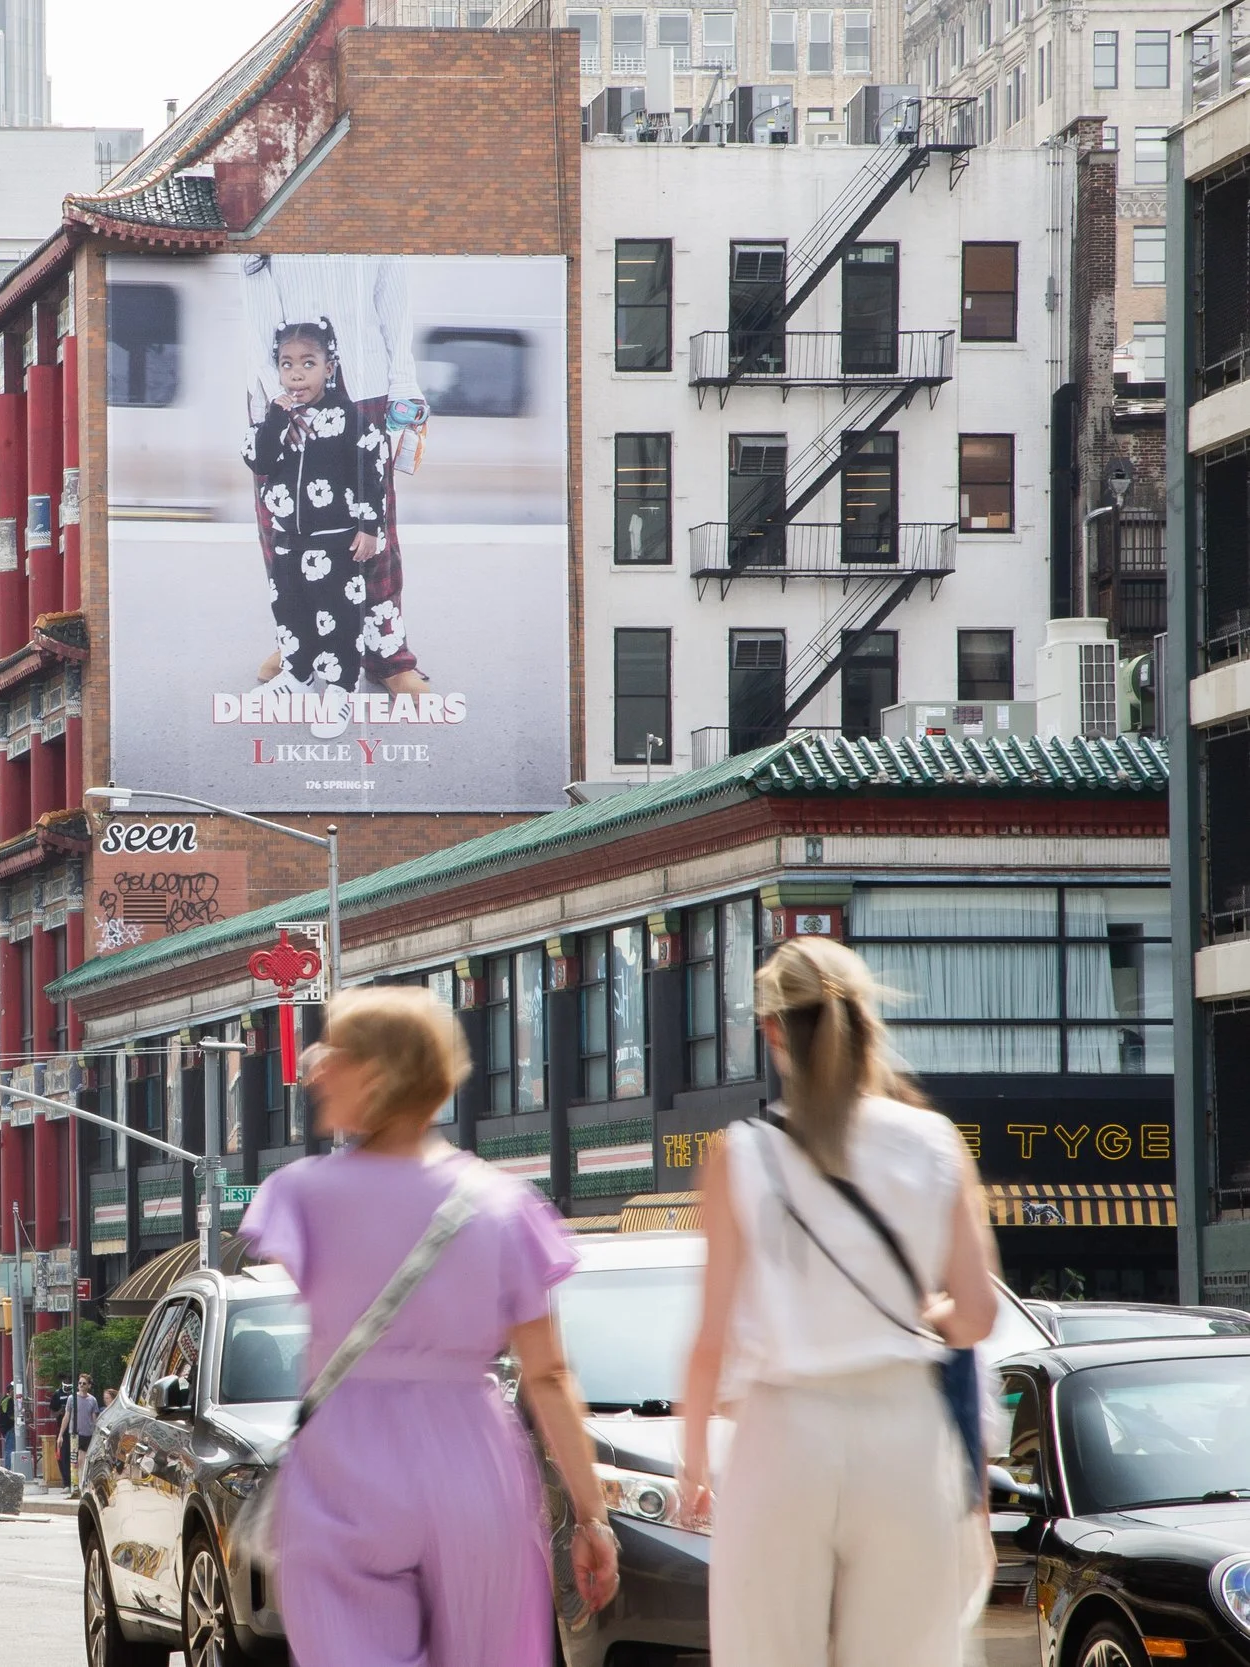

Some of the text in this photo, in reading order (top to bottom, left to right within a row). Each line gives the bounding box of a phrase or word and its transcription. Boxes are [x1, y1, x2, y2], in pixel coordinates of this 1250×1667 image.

[212, 692, 467, 725] DENIM TEARS
[252, 738, 430, 765] LIKKLE YUTE
[305, 780, 376, 790] 176 SPRING ST
[101, 823, 197, 854] seen
[223, 1188, 258, 1201] HESTE
